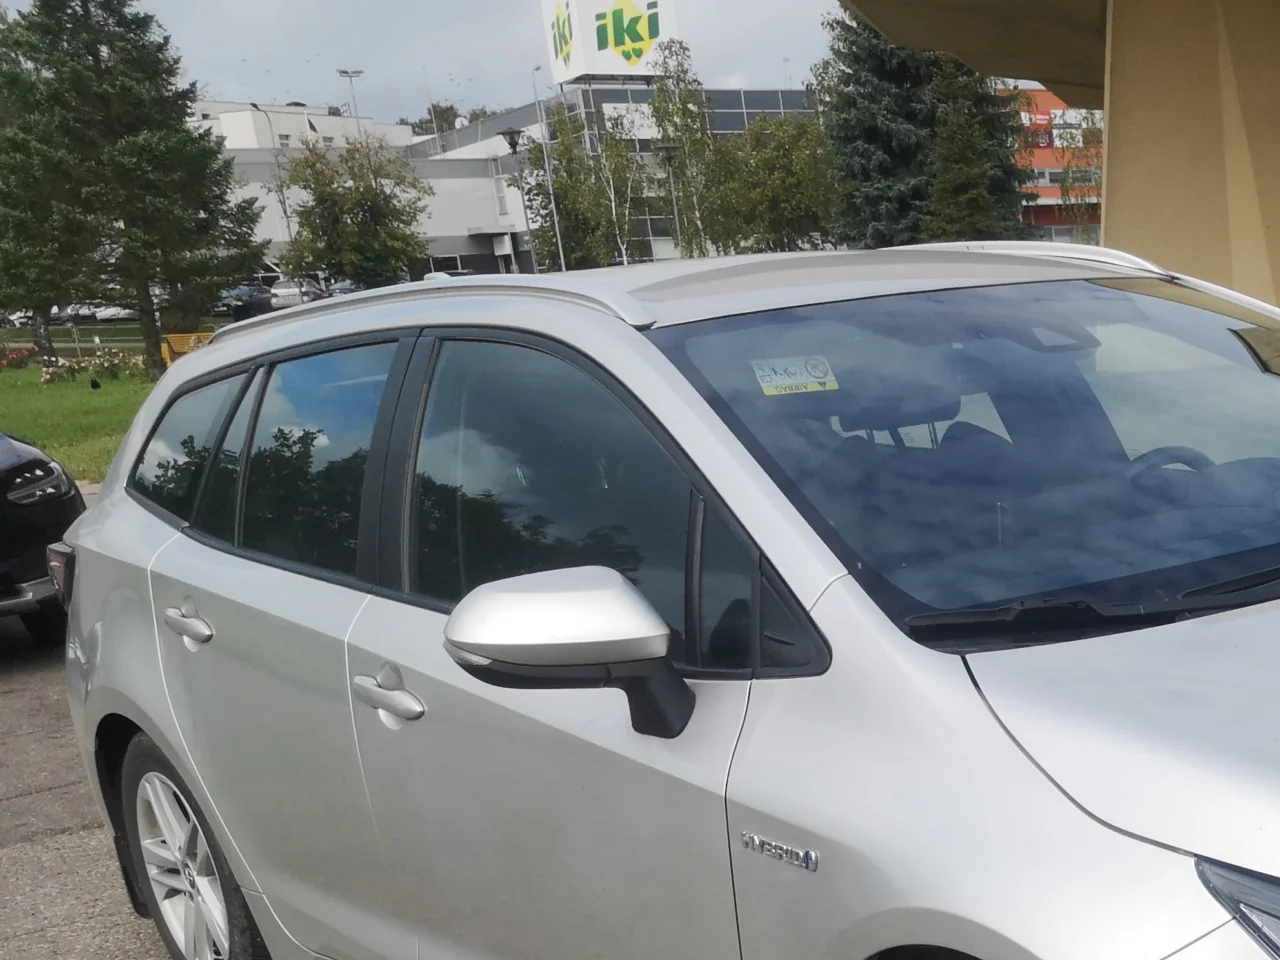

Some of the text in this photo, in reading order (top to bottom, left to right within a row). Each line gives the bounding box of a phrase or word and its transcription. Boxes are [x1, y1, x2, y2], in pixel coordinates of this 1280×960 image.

[551, 1, 573, 60] iki
[595, 0, 660, 51] iki
[774, 383, 808, 393] AIRBAG
